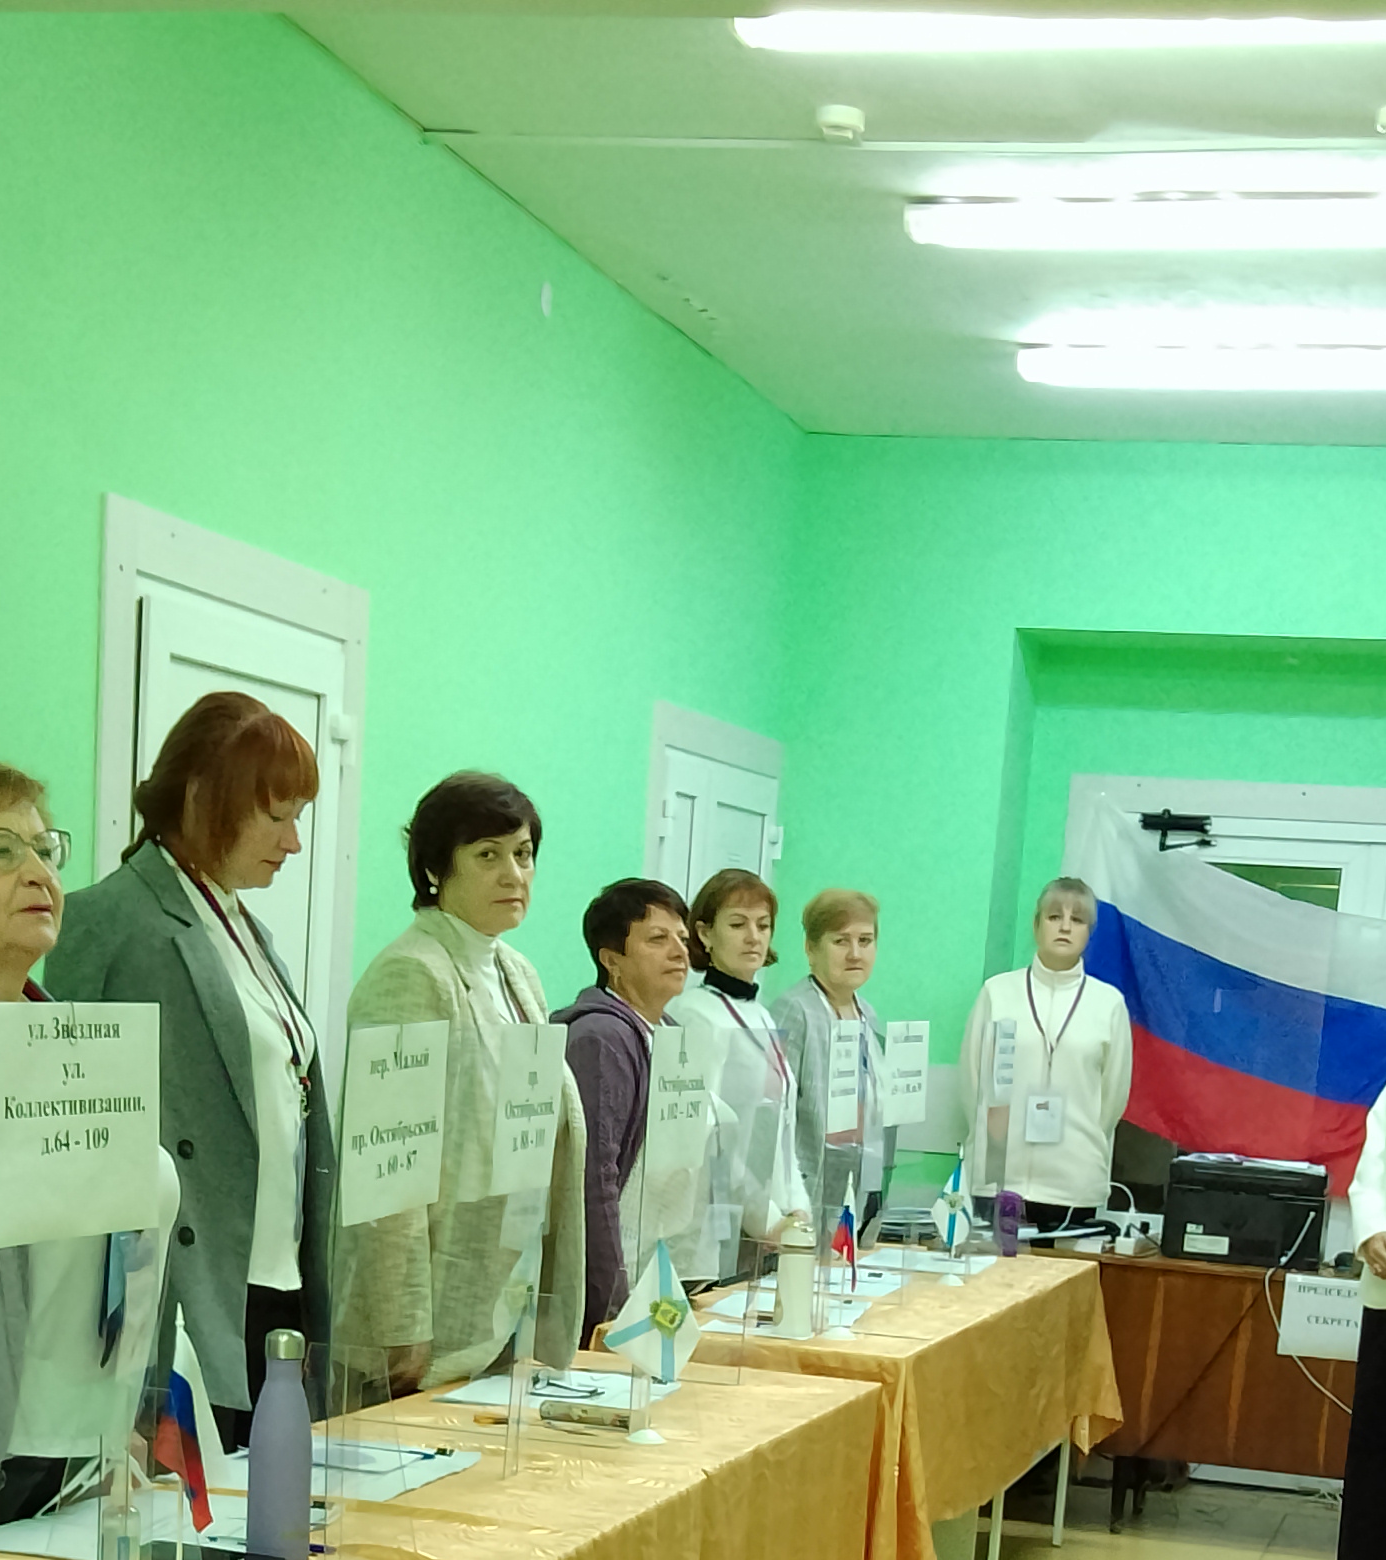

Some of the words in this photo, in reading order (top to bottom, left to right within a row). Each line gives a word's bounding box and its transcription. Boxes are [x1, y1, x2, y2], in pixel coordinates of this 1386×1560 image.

[27, 1024, 49, 1047] ул.
[52, 1016, 121, 1041] Звездная
[62, 1063, 85, 1086] ул.
[4, 1096, 146, 1119] Коллективизации,
[85, 1127, 109, 1150] 109
